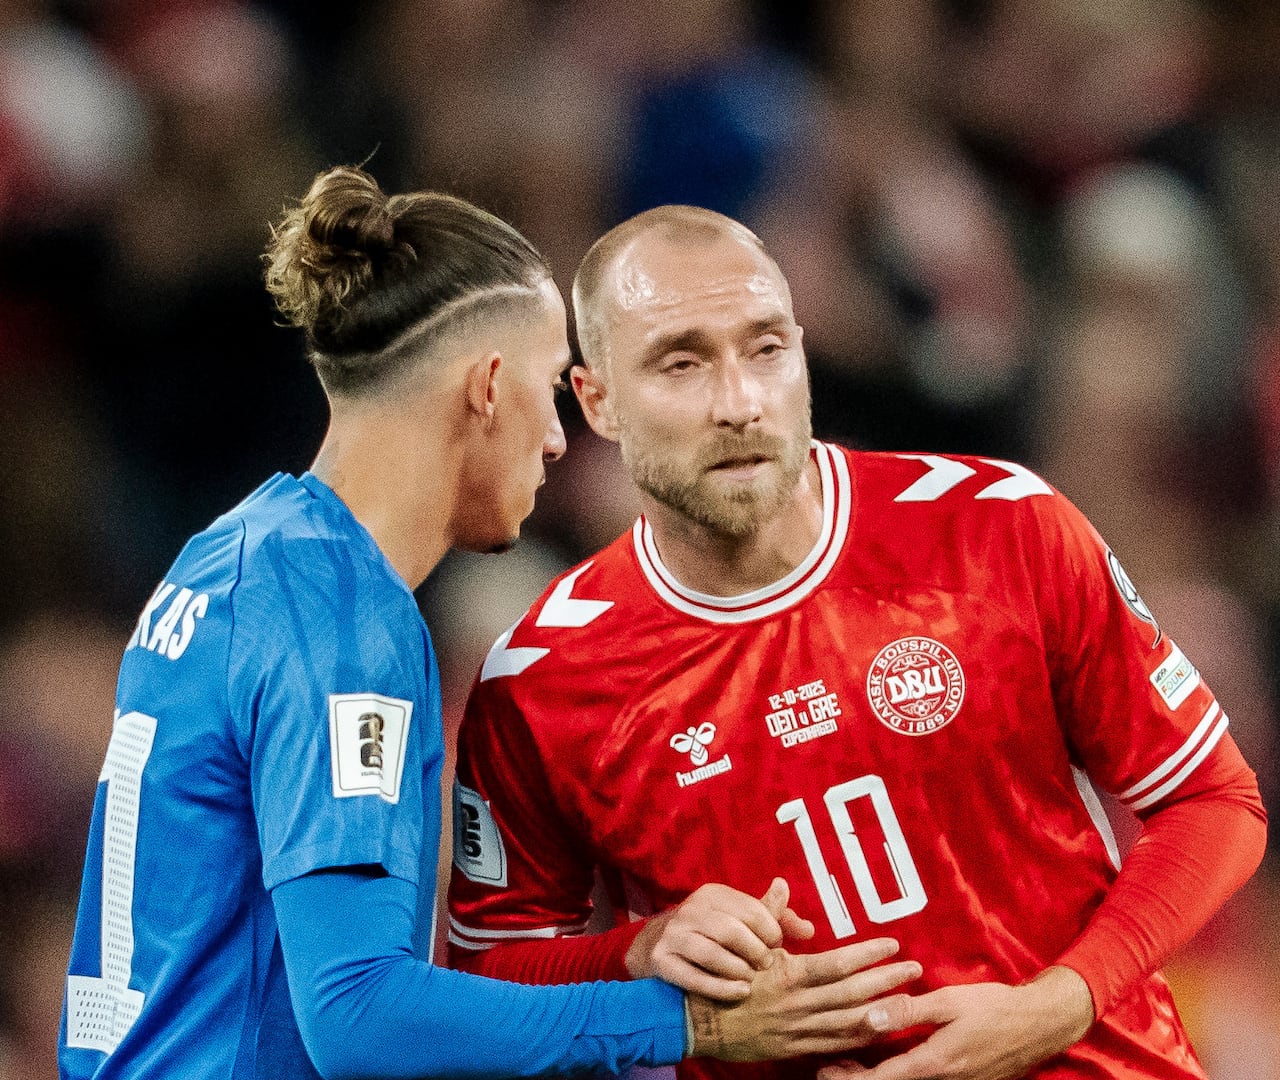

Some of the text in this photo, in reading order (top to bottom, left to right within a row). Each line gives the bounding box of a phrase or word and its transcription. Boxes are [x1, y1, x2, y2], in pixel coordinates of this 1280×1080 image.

[870, 674, 903, 728] DANSK
[943, 658, 962, 712] UNION
[885, 665, 946, 705] DBU
[764, 707, 799, 738] DEN
[807, 692, 842, 723] GRE
[907, 713, 945, 733] 1889
[675, 753, 733, 788] hummel
[775, 774, 929, 940] 10
